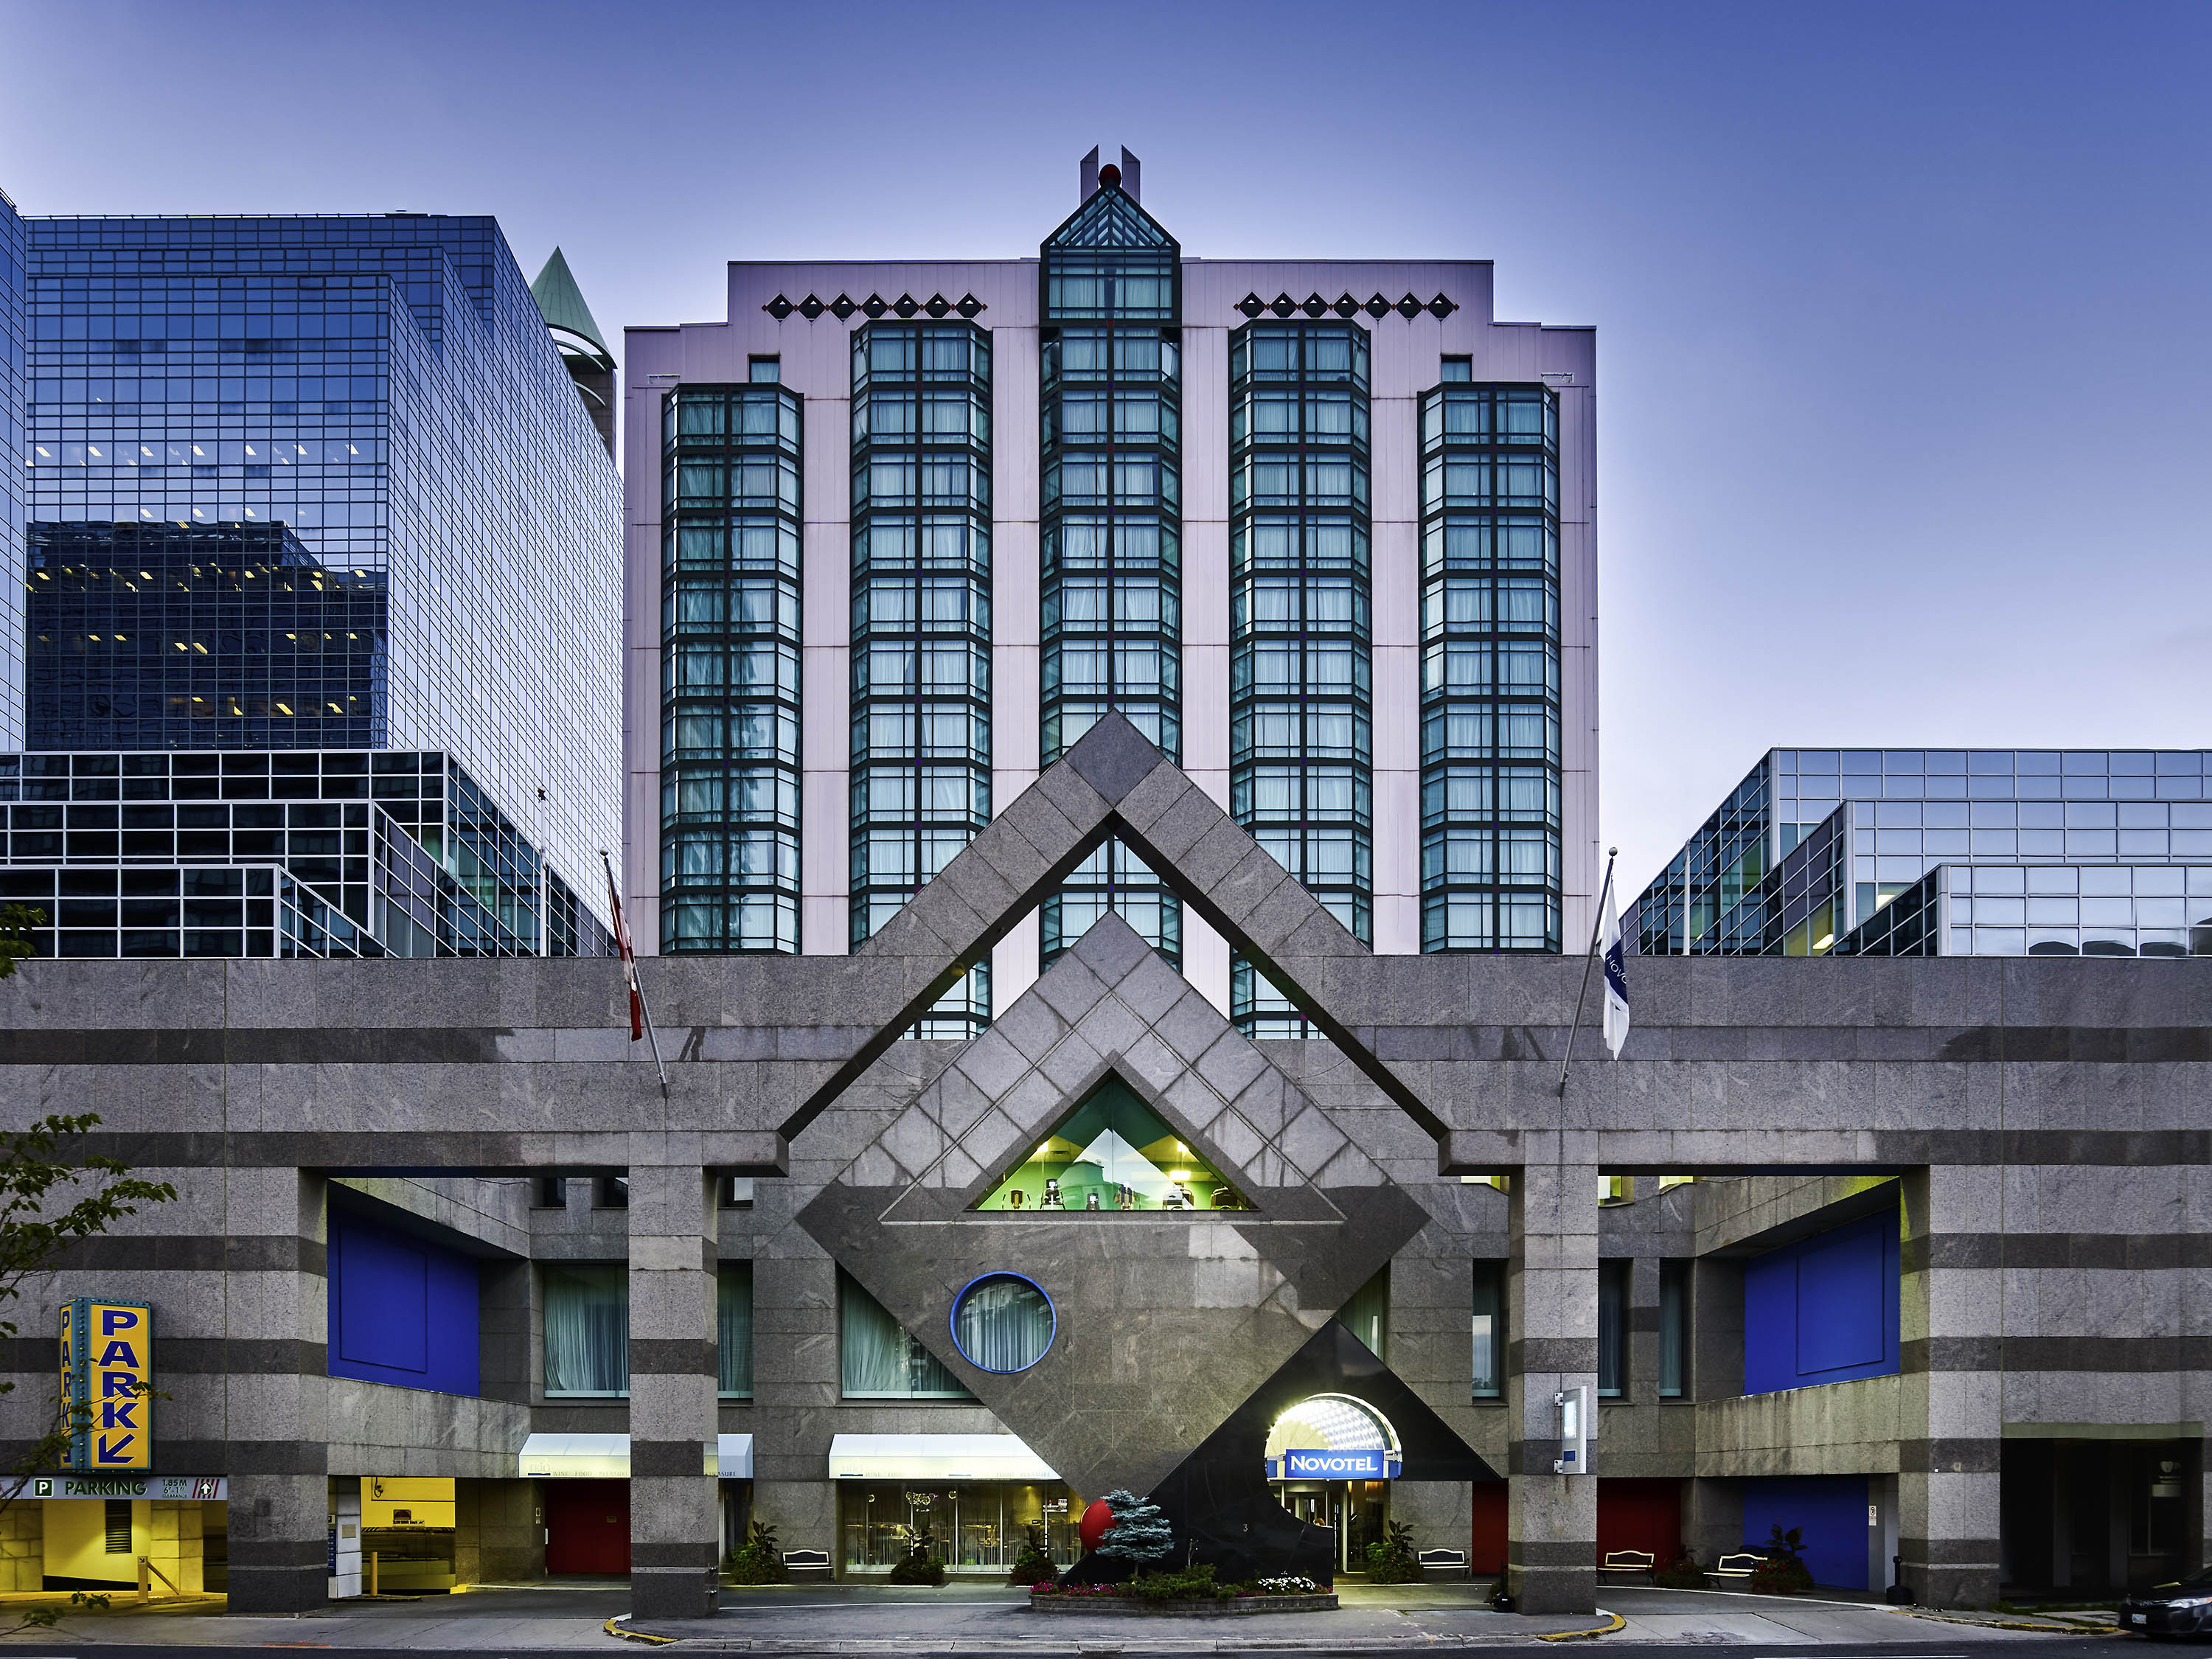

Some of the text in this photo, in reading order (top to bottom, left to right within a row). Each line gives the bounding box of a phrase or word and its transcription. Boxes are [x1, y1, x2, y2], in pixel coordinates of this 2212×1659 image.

[61, 1310, 72, 1429] PARK
[97, 1309, 140, 1429] PARK
[1290, 1455, 1379, 1471] NOVOTEL
[39, 1481, 49, 1495] P
[65, 1481, 147, 1495] PARKING
[1242, 1523, 1248, 1532] 3
